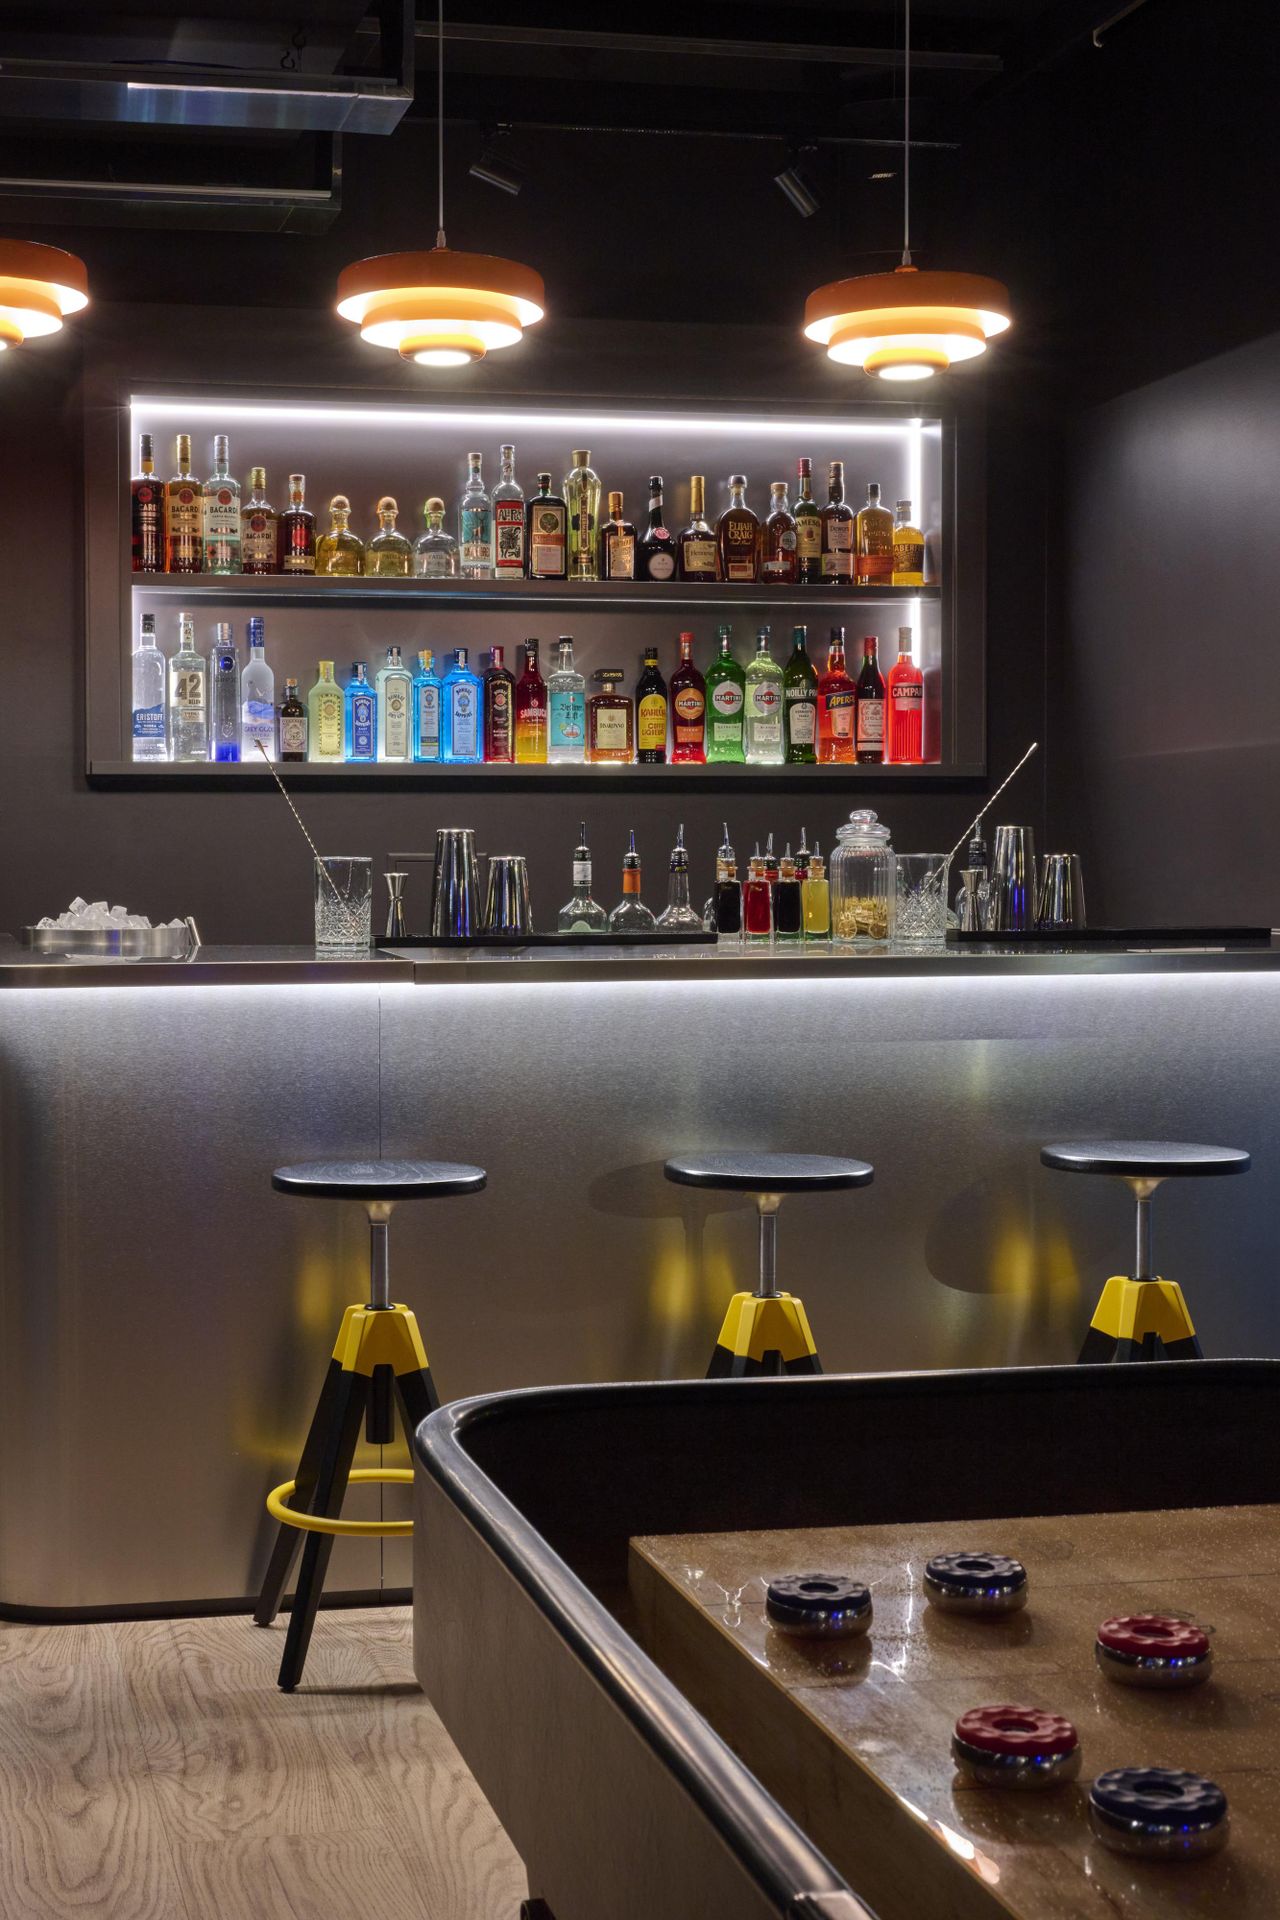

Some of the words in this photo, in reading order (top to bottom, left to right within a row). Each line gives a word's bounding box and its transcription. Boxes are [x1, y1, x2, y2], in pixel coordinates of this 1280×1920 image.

[171, 505, 199, 513] BACARD
[728, 521, 753, 531] ELIJAH
[728, 530, 753, 540] CRAIG
[175, 673, 202, 700] 42
[785, 688, 807, 698] NOILLY
